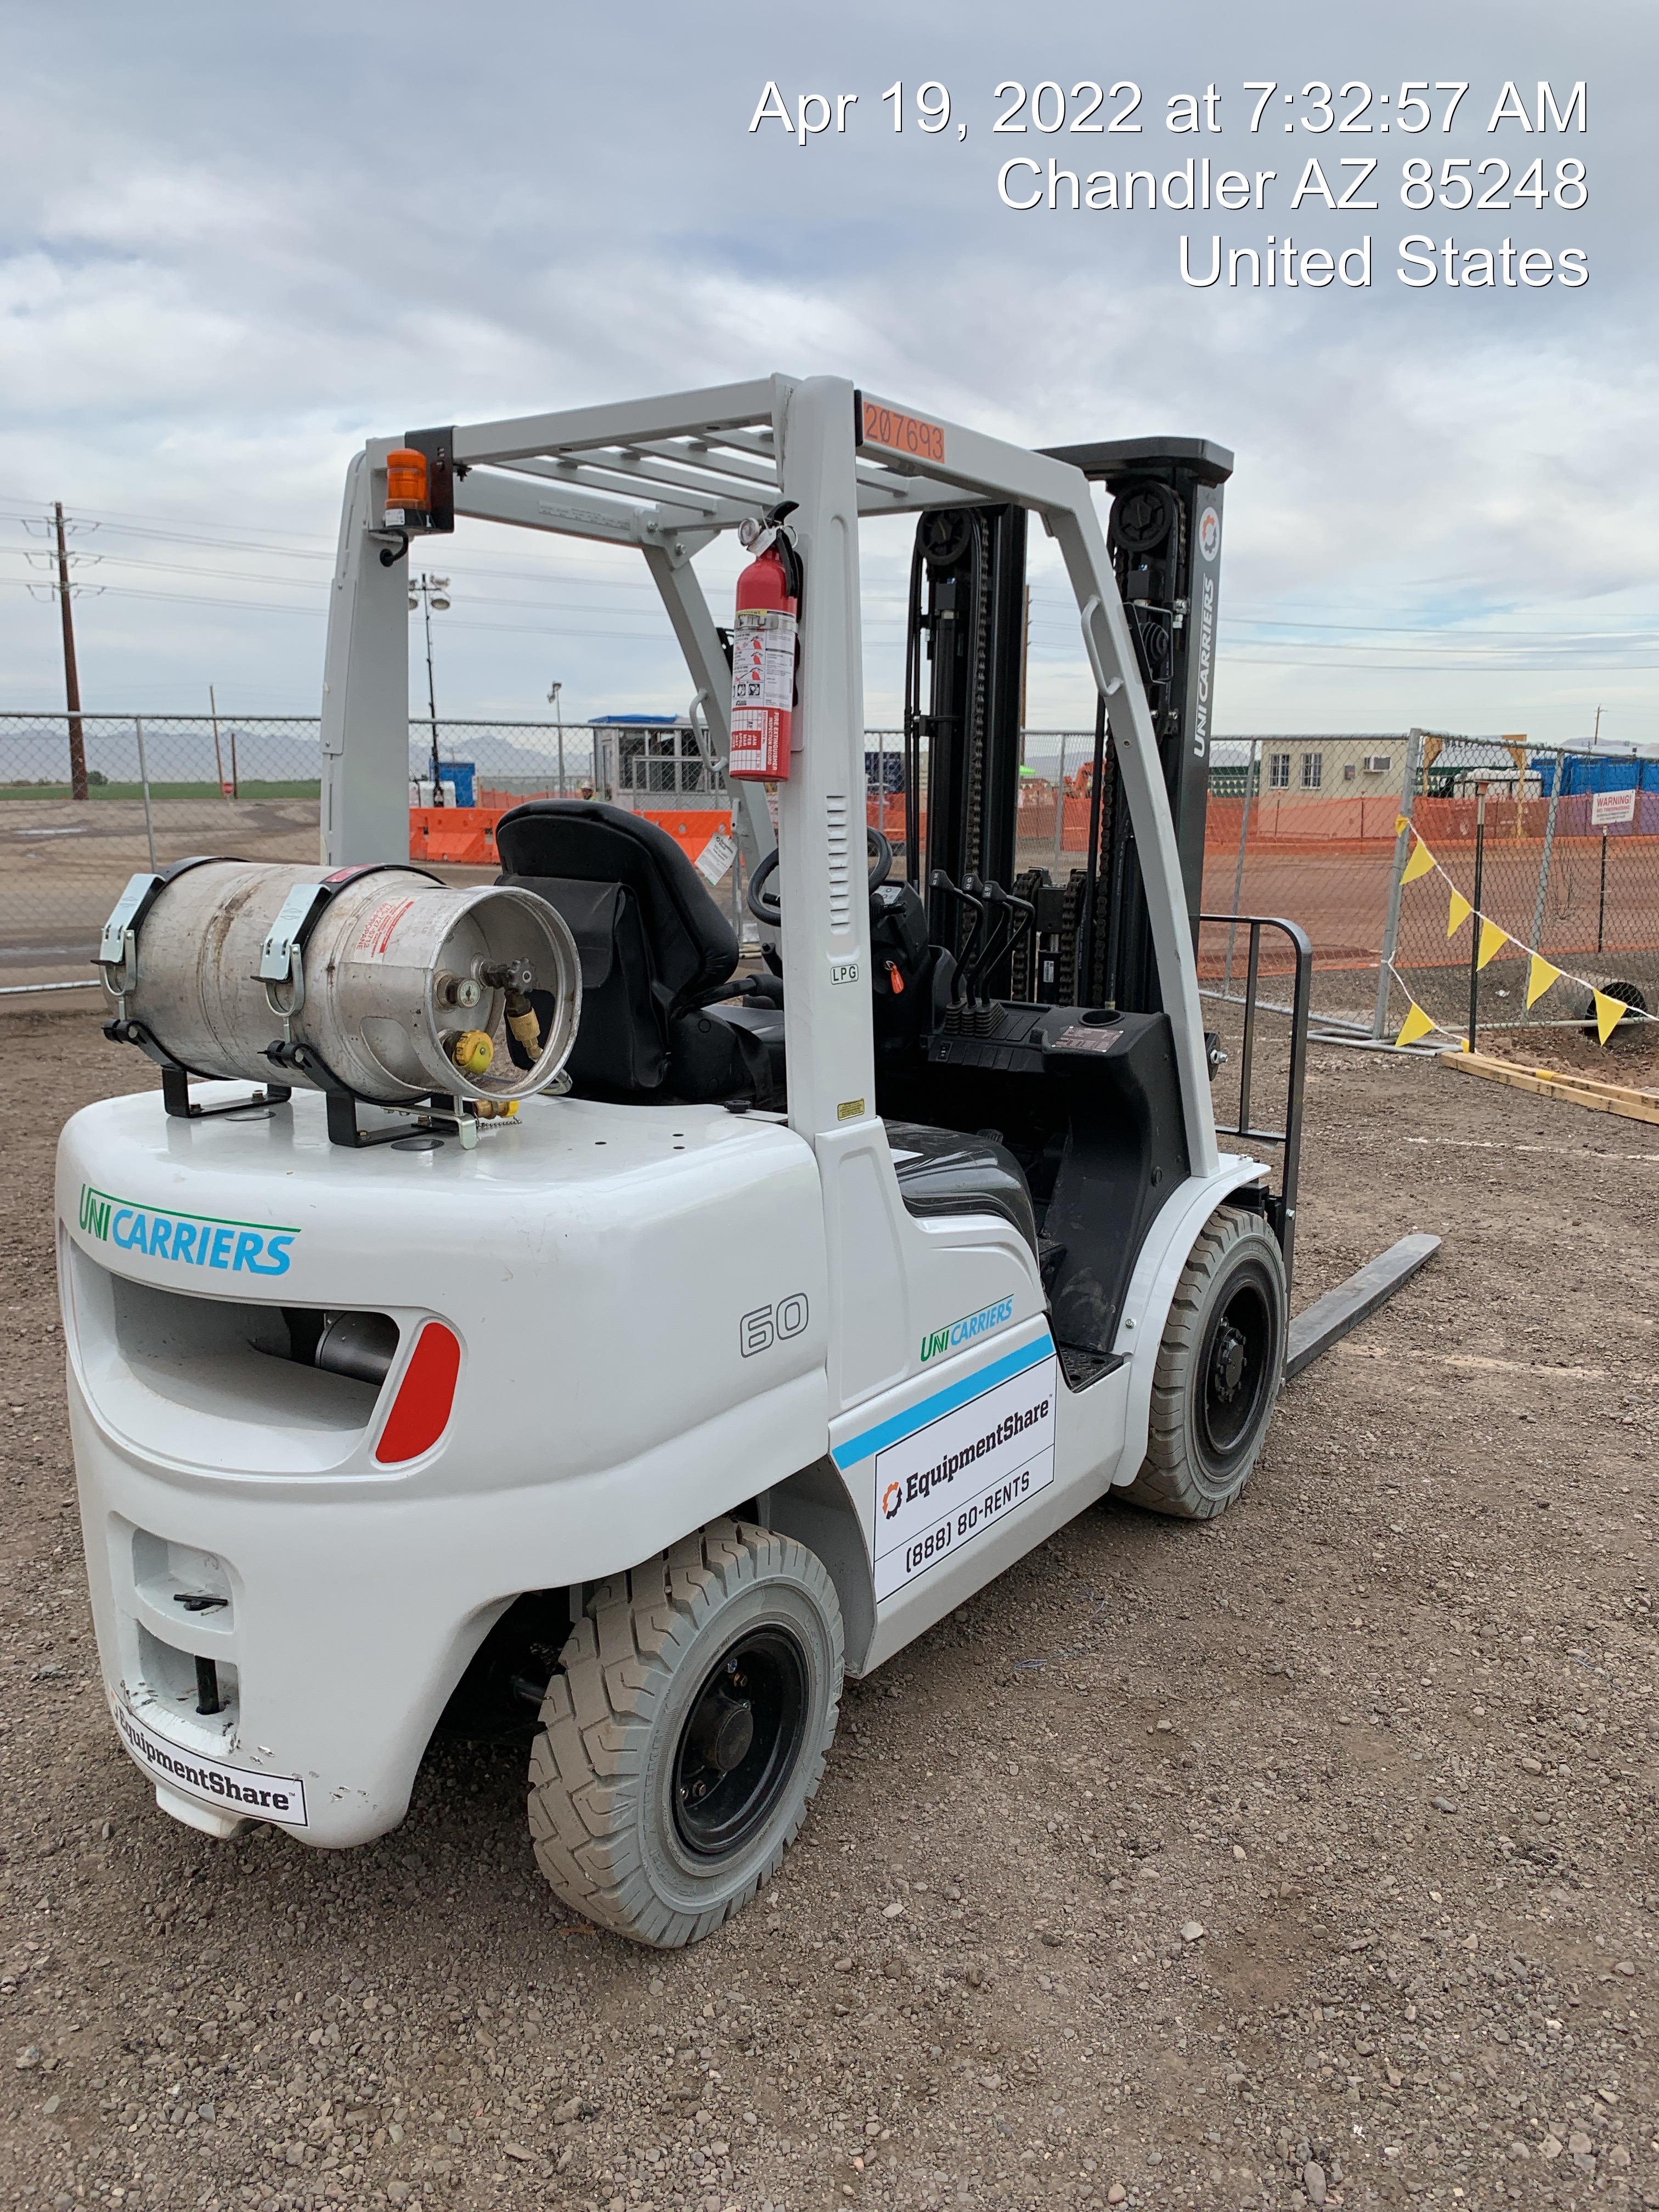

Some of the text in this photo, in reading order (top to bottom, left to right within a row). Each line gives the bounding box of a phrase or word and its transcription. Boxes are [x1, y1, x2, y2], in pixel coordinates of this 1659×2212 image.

[866, 404, 943, 460] 207693
[1194, 574, 1214, 758] UNICARRIERS
[1597, 794, 1632, 807] WARNING!
[833, 966, 856, 981] LPG
[79, 1183, 296, 1276] UNICARRIERS
[740, 1293, 809, 1358] 60
[921, 1298, 1013, 1362] UNICARRIERS
[906, 1400, 1048, 1503] EquipmentShare
[906, 1470, 1030, 1573] (888) 80-RENTS
[120, 1708, 289, 1811] EquipmentShare
